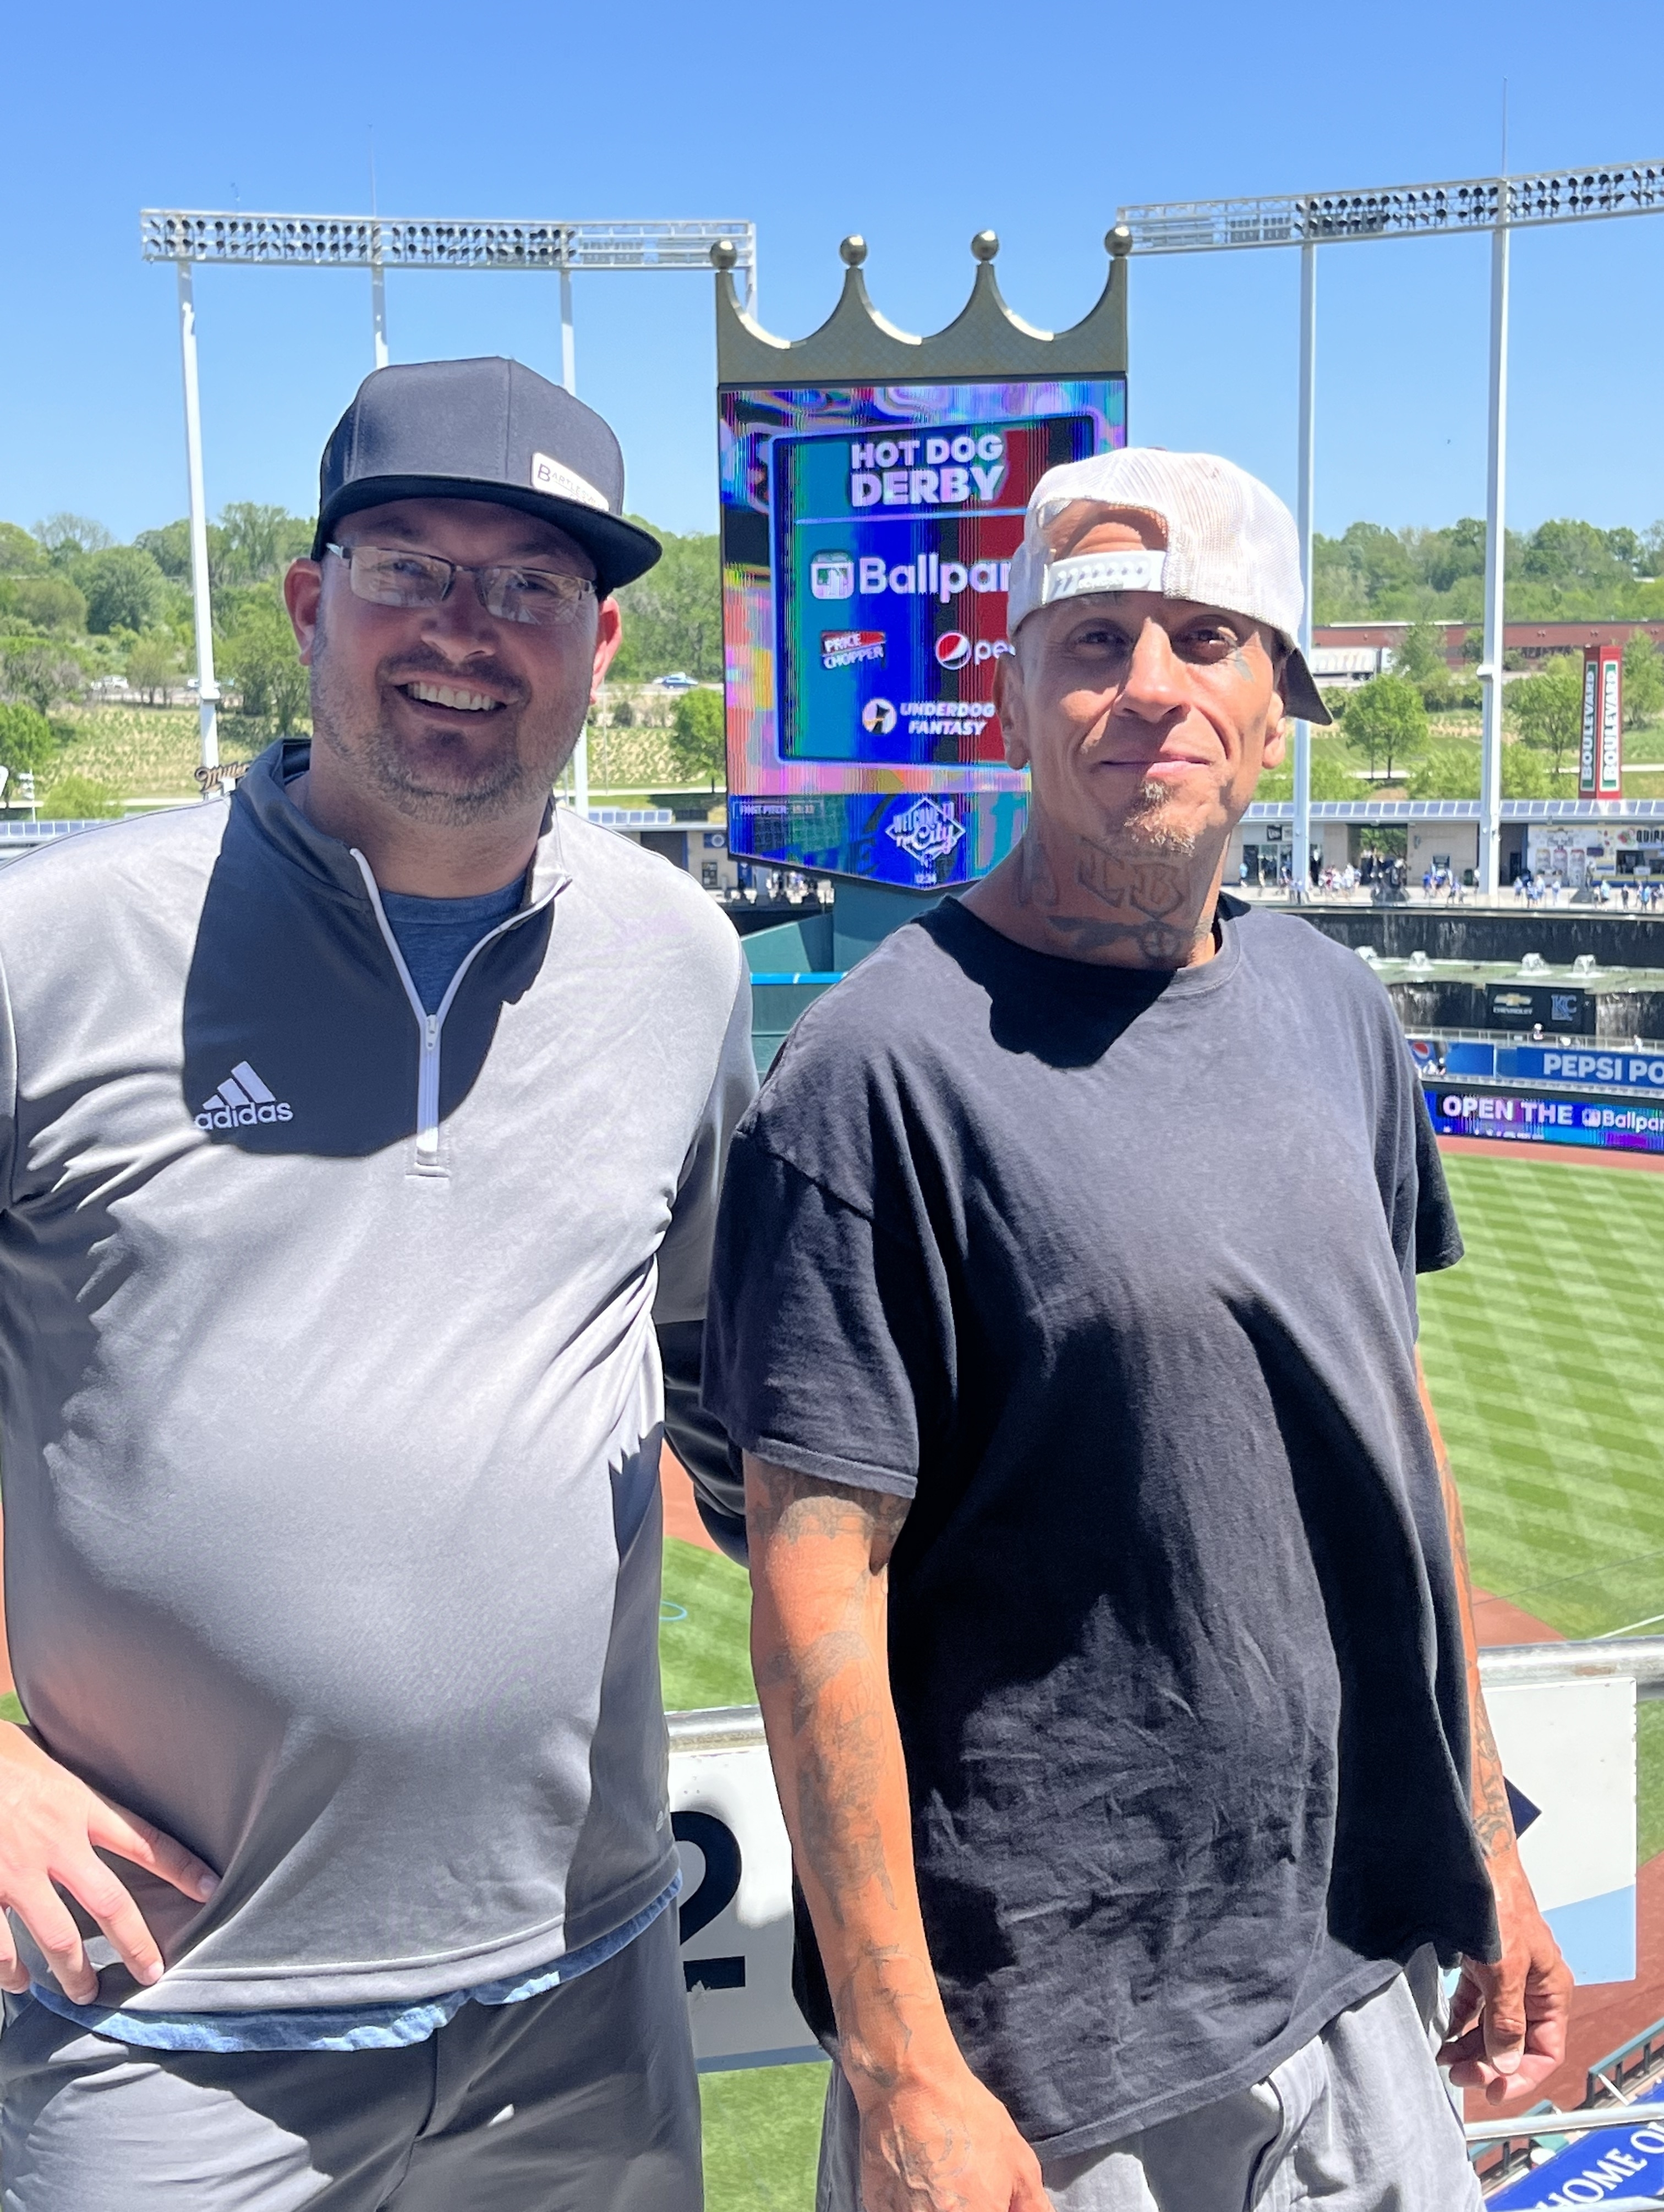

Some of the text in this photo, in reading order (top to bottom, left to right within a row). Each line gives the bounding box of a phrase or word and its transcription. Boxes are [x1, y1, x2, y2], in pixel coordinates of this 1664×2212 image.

[852, 435, 1004, 469] HOT DOG
[851, 465, 1005, 507] DERBY
[824, 633, 861, 652] PRICE
[823, 646, 884, 669] CHOPPER
[900, 702, 995, 717] UNDERDOG
[908, 720, 988, 735] FANTASY
[1581, 671, 1595, 780] BOULEVARD
[1603, 670, 1617, 781] BOULEVARD
[1544, 1053, 1622, 1081] PEPSI
[194, 1102, 294, 1130] adidas
[1443, 1095, 1513, 1121] OPEN
[1520, 1102, 1573, 1126] THE
